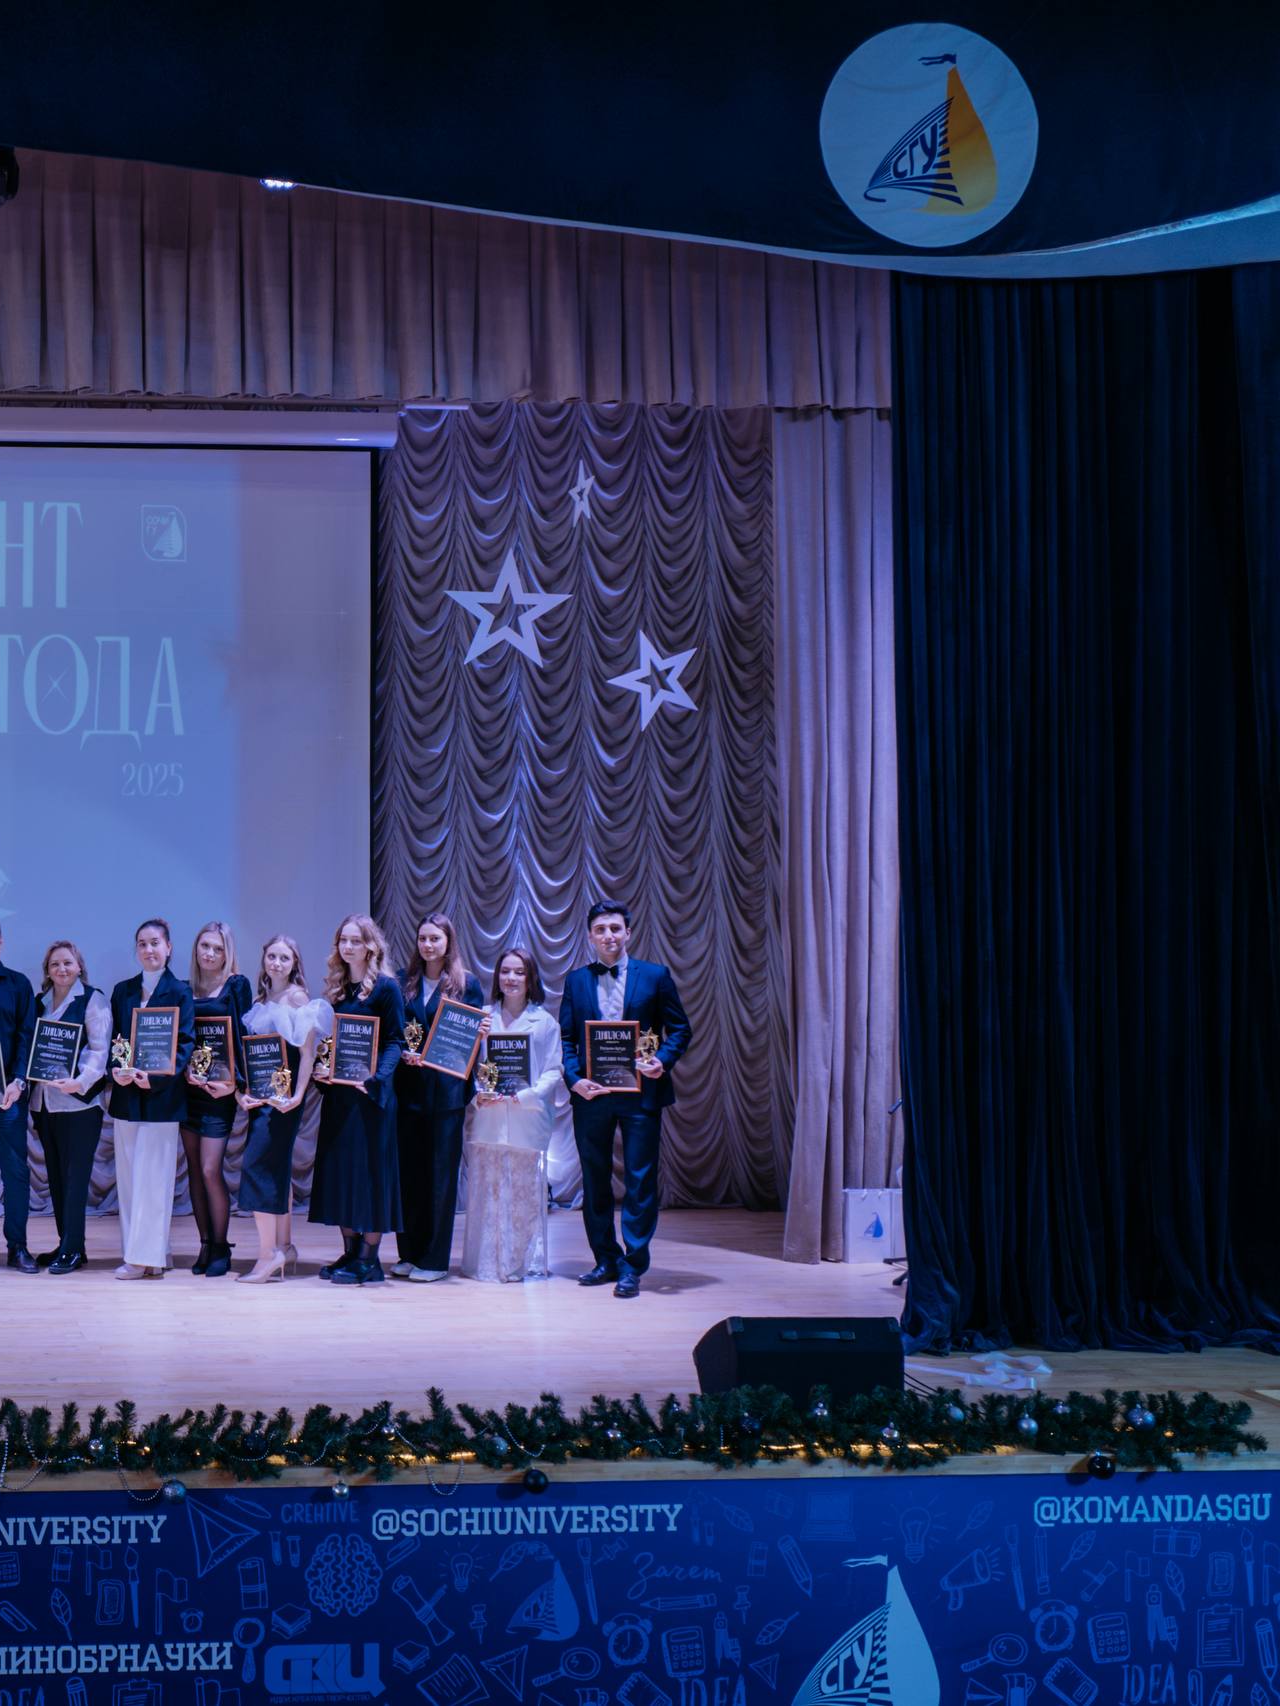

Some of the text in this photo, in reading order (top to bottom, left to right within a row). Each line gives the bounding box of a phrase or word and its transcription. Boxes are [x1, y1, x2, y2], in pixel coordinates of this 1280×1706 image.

[121, 762, 184, 797] 2025
[372, 1504, 683, 1541] @SOCHIUNIVERSITY
[1034, 1493, 1272, 1527] @KOMANDASGU
